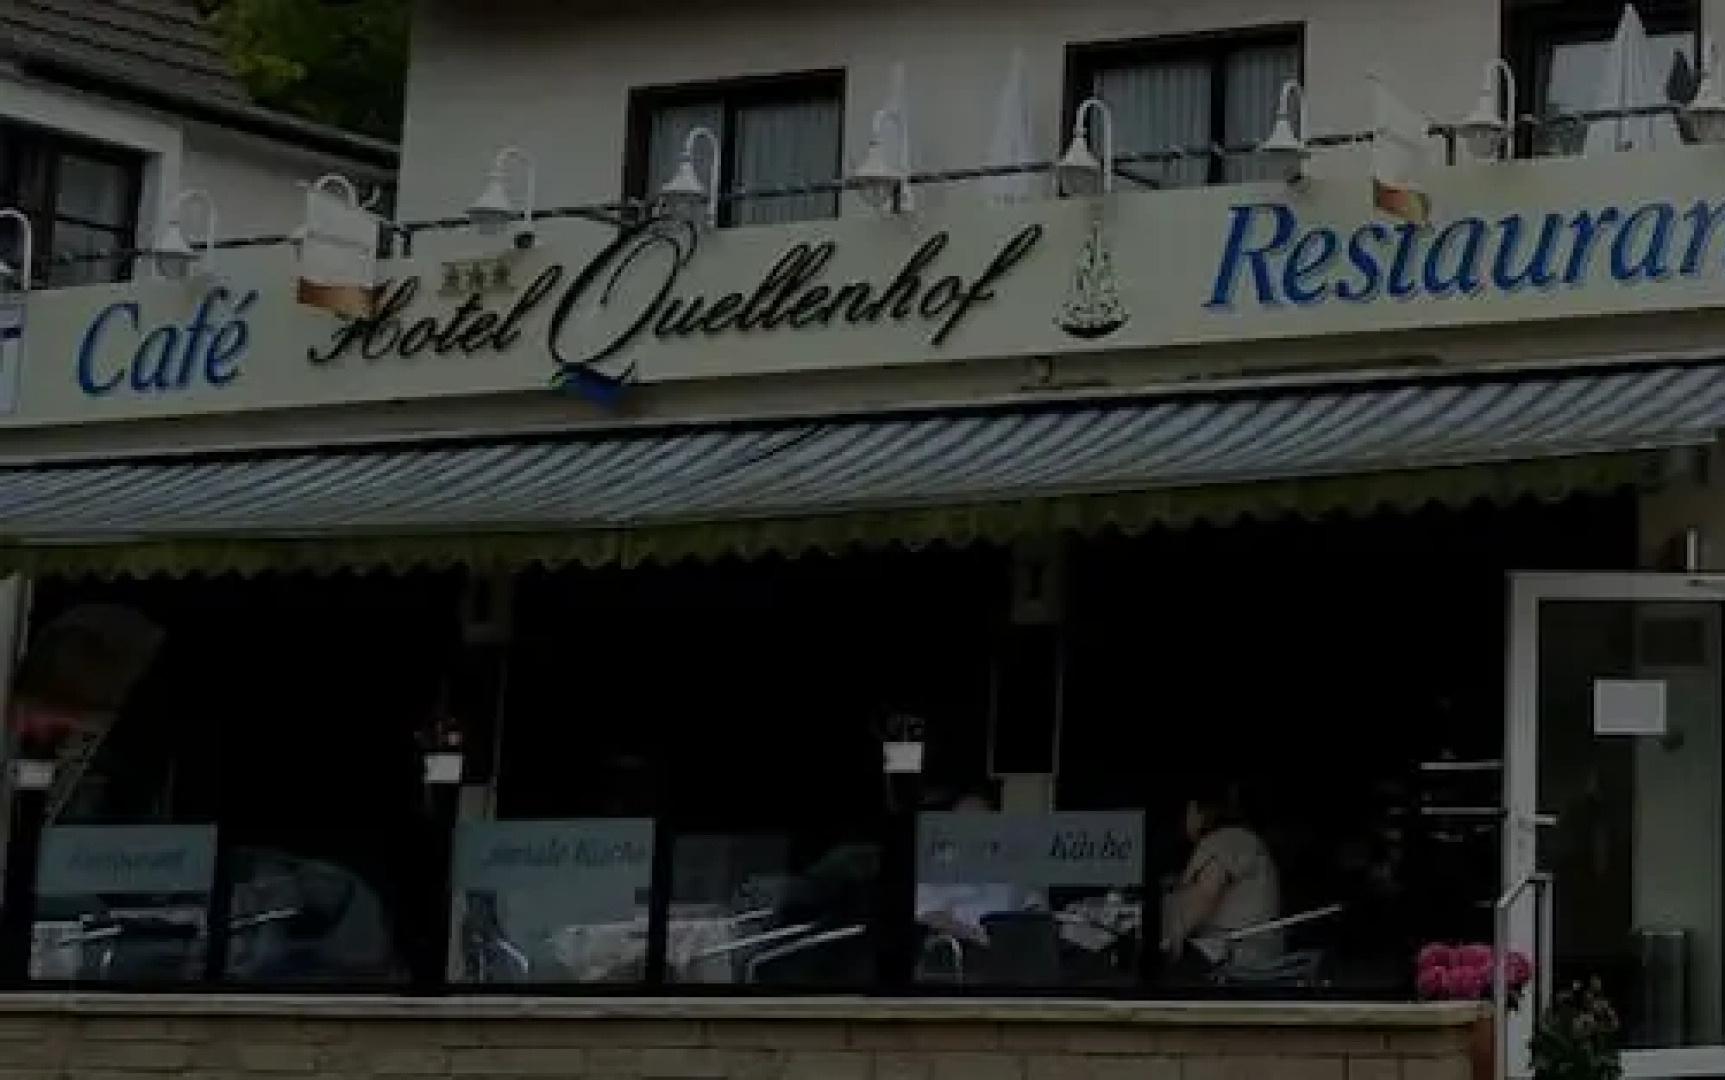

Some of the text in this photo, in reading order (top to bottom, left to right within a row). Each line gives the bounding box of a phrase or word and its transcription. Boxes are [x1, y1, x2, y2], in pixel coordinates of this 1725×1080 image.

[76, 284, 258, 396] Café
[307, 214, 1044, 384] Hotel Quellenhof
